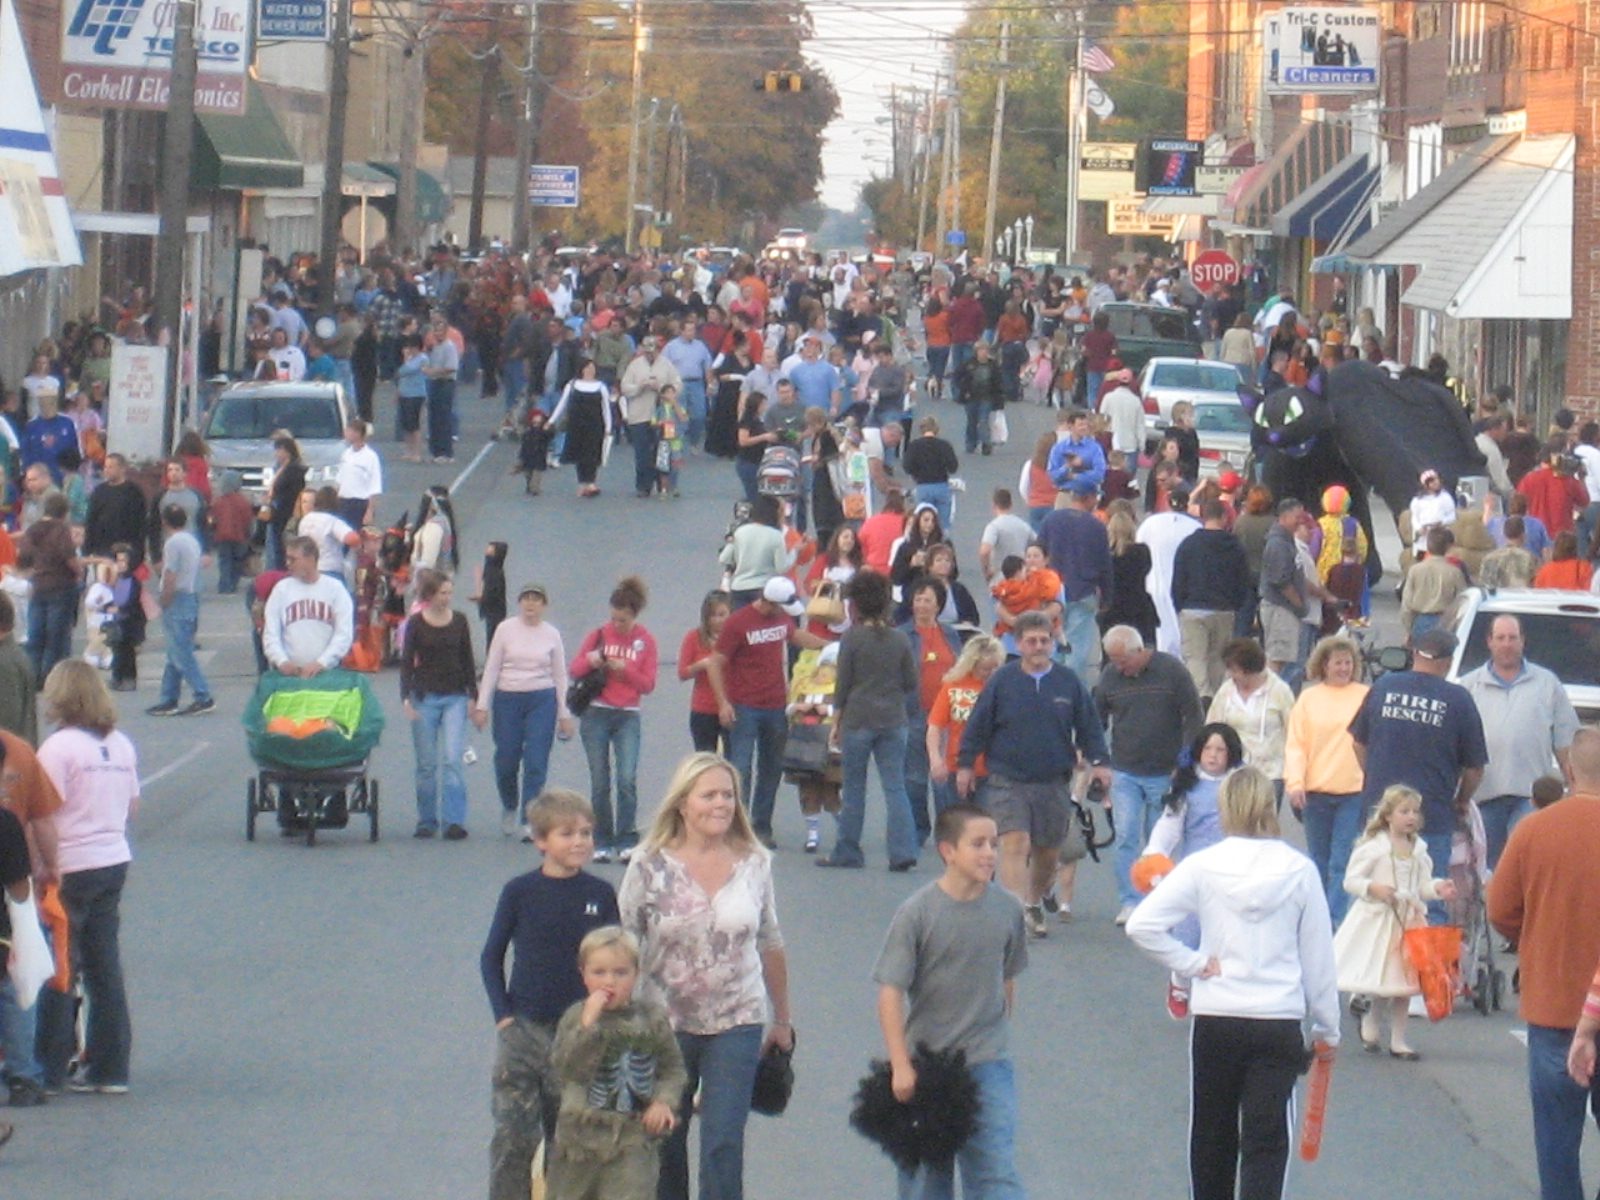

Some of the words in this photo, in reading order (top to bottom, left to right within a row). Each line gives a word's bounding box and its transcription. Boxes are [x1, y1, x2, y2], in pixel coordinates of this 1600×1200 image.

[211, 6, 243, 32] Inc.
[264, 4, 299, 16] WATER
[301, 5, 323, 16] AND
[1286, 12, 1318, 25] Tri-C
[1325, 13, 1377, 26] Custom
[1290, 69, 1371, 82] Cleaners
[63, 72, 134, 100] Corbell
[136, 78, 241, 108] Eleonics
[1194, 264, 1235, 281] STOP
[1384, 692, 1448, 714] FIRE
[1382, 705, 1444, 728] RESCUE
